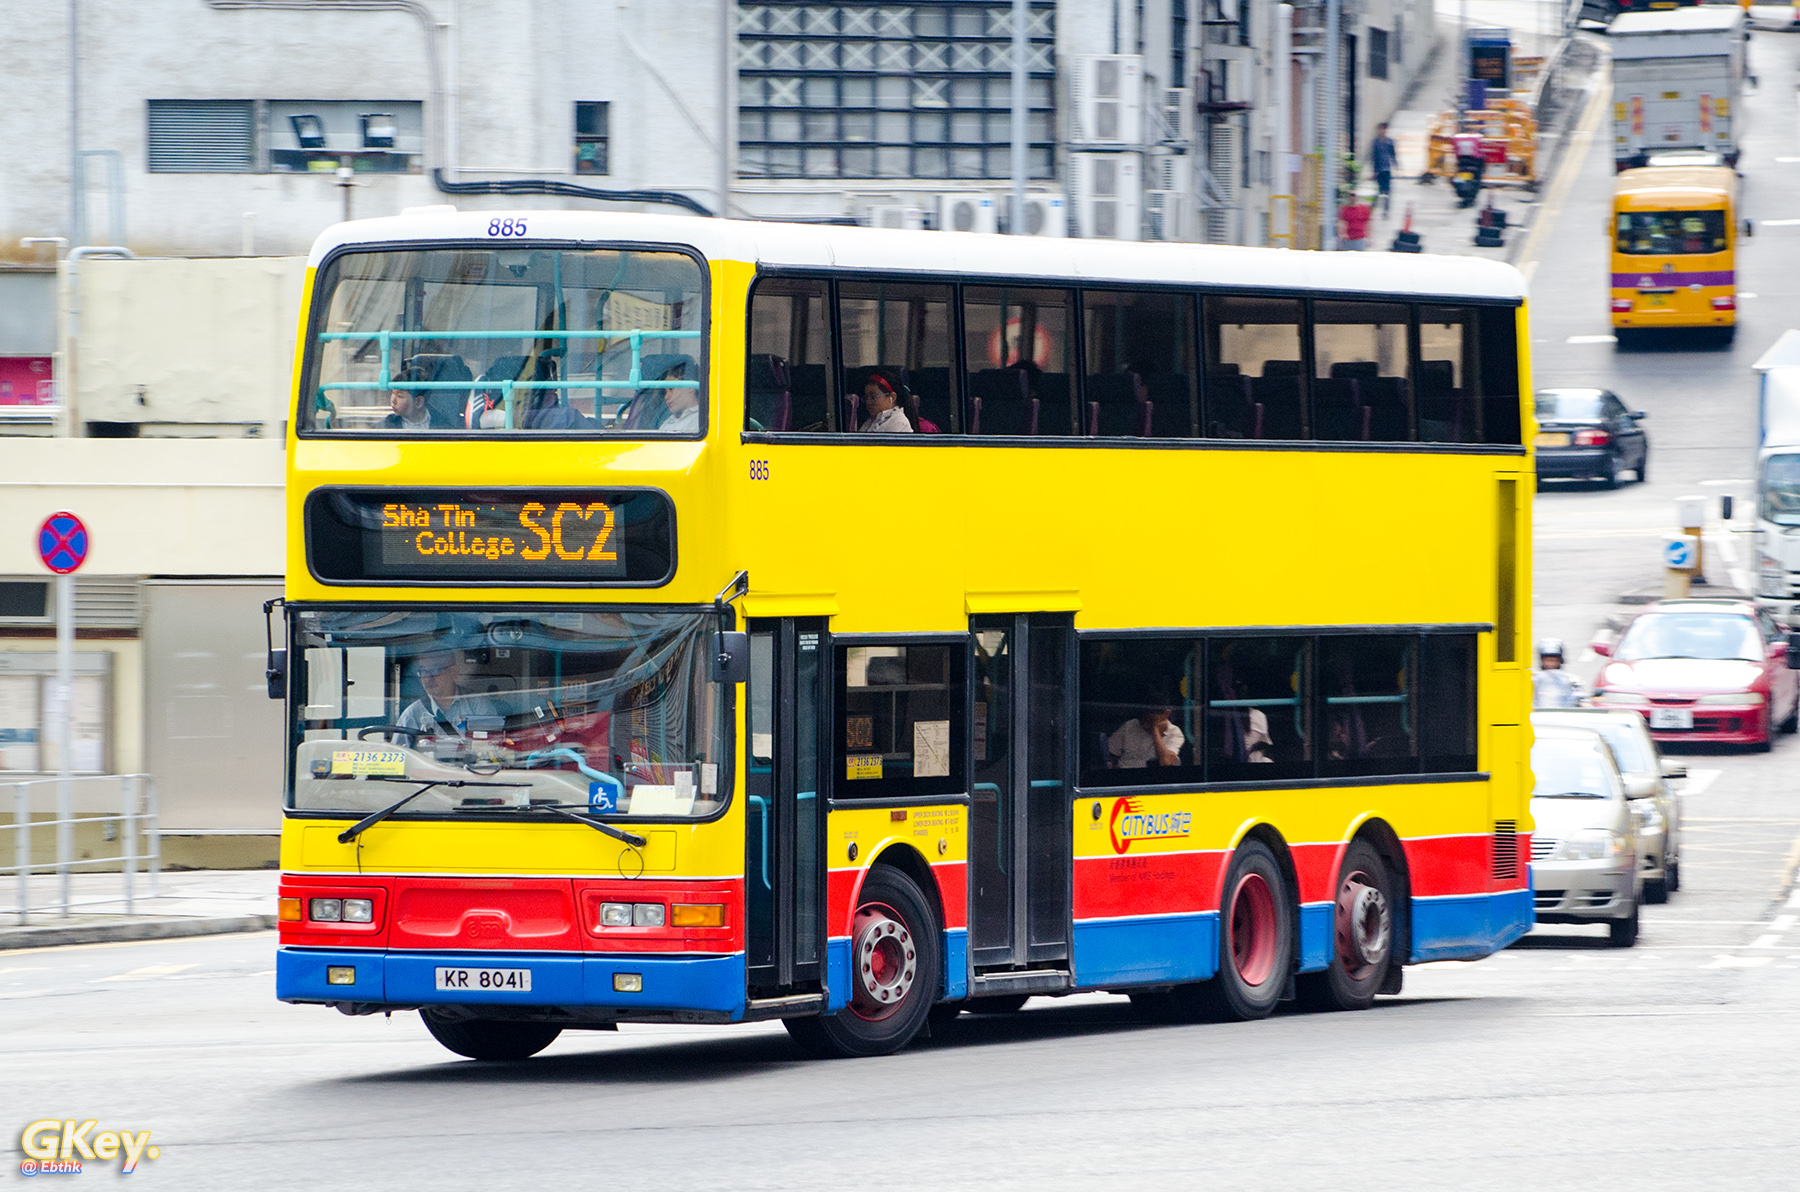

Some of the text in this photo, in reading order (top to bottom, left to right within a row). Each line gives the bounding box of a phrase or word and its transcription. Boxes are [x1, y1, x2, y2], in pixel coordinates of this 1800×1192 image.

[487, 217, 528, 237] 885
[749, 459, 770, 481] 885
[382, 504, 476, 527] Sha Tin
[519, 502, 617, 560] SC2
[415, 531, 515, 560] College
[353, 752, 378, 762] 2136
[380, 752, 405, 763] 2373
[1121, 813, 1170, 836] CITYBUS
[1171, 810, 1193, 834] 城巴
[444, 970, 524, 989] KR 8041
